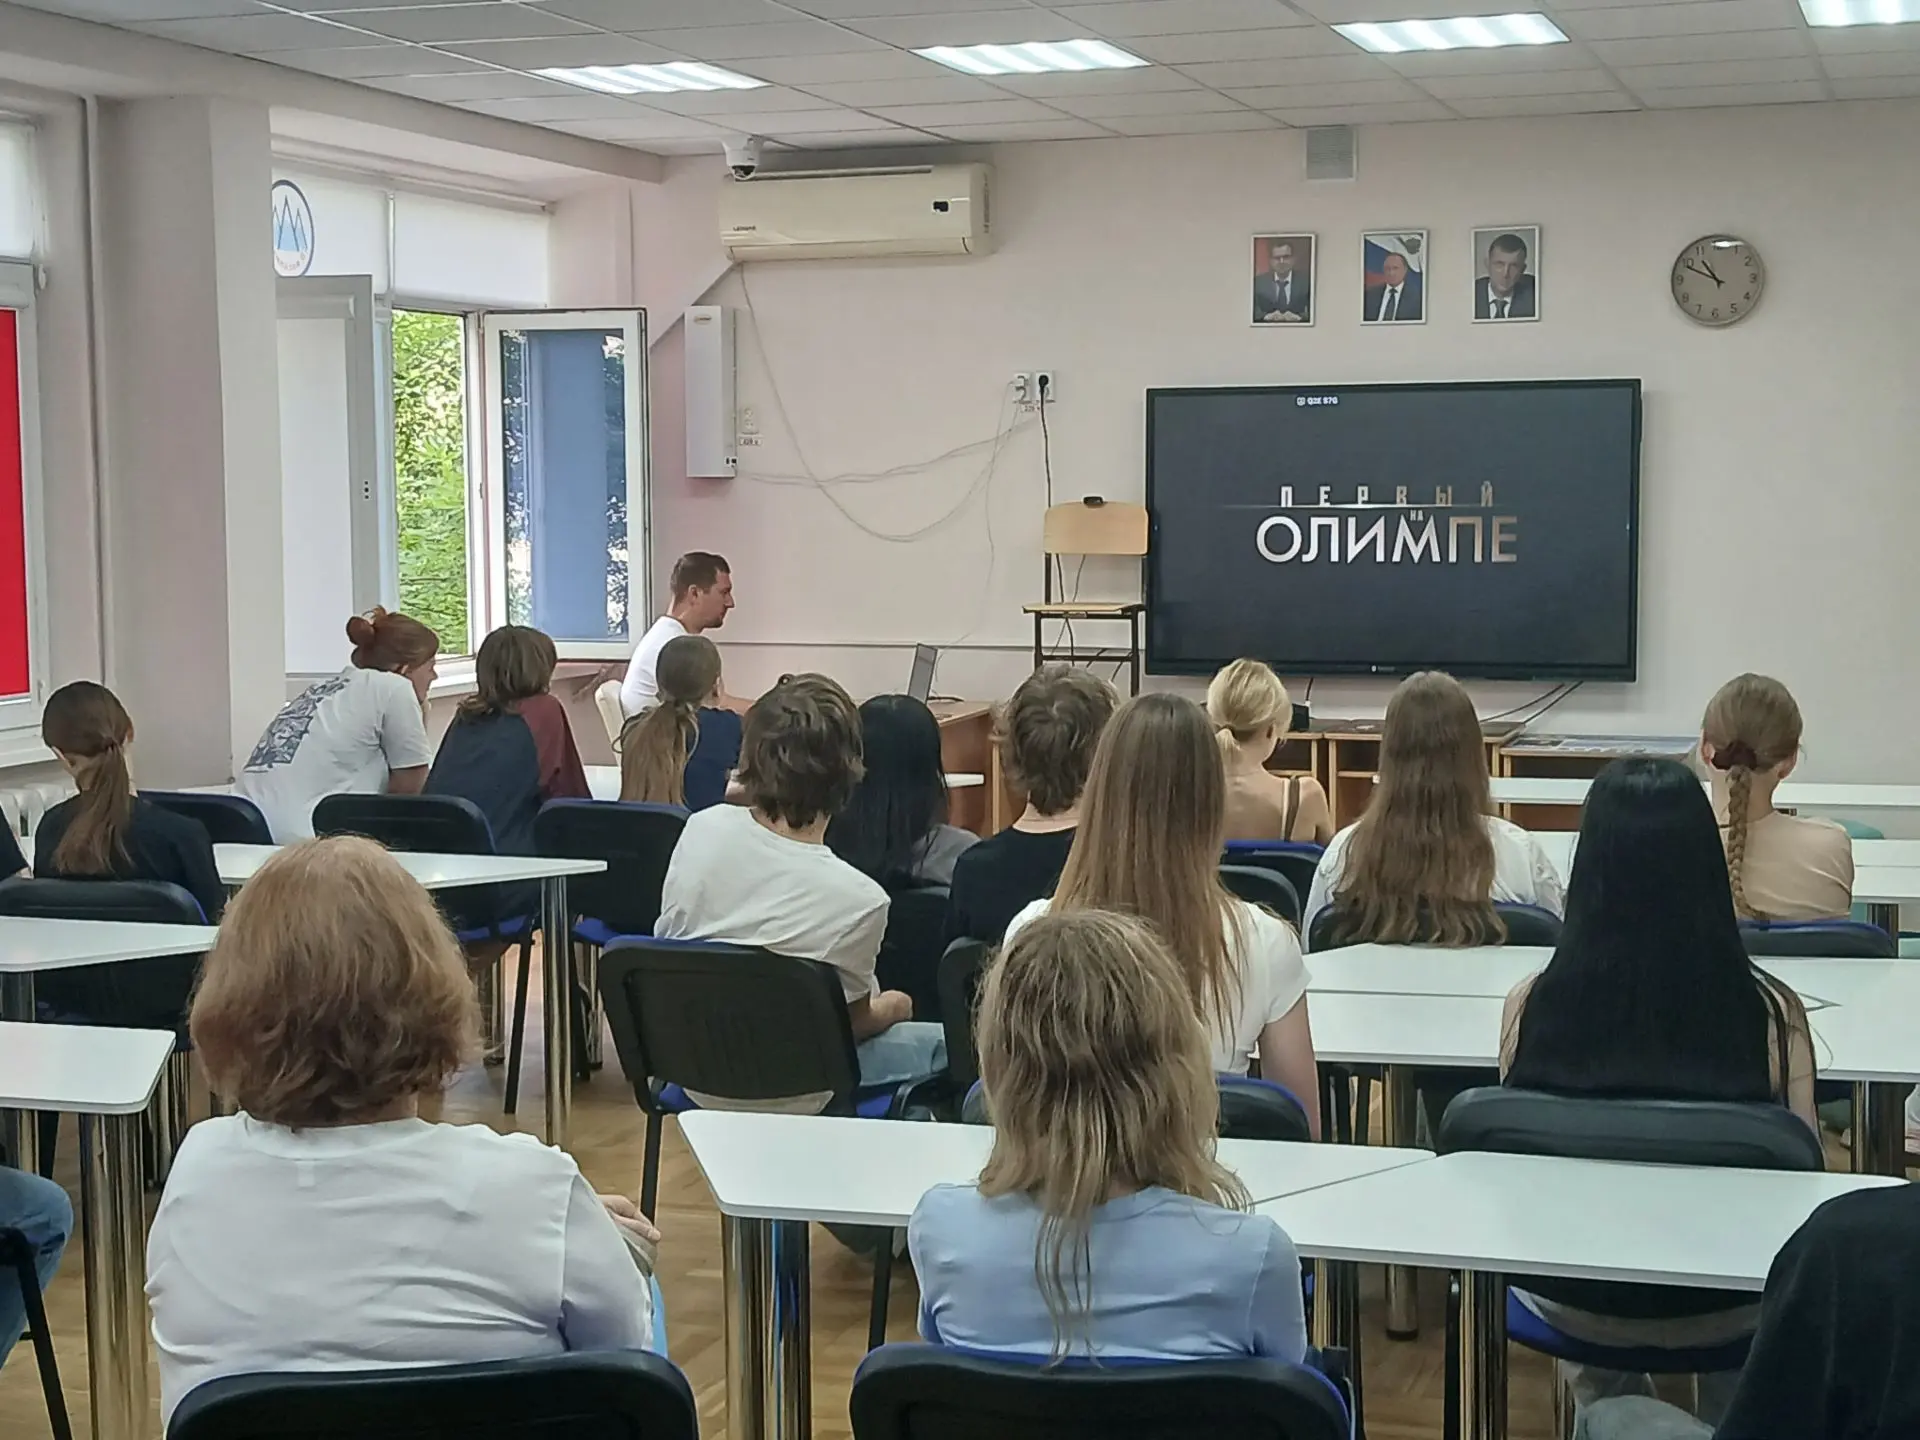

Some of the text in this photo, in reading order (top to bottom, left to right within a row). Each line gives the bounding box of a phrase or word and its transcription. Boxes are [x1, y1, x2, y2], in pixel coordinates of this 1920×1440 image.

[1696, 245, 1704, 255] 11
[1683, 258, 1694, 268] 10
[1744, 256, 1752, 266] 2
[1676, 274, 1684, 285] 9
[1749, 273, 1757, 283] 3
[1682, 292, 1689, 303] 8
[1743, 291, 1750, 300] 4
[1696, 304, 1702, 314] 7
[1730, 303, 1737, 313] 5
[1711, 308, 1719, 319] 6
[1280, 480, 1493, 507] ПЕРВЫЙ
[1410, 510, 1424, 521] НА
[1256, 515, 1517, 563] ОЛИМПЕ
